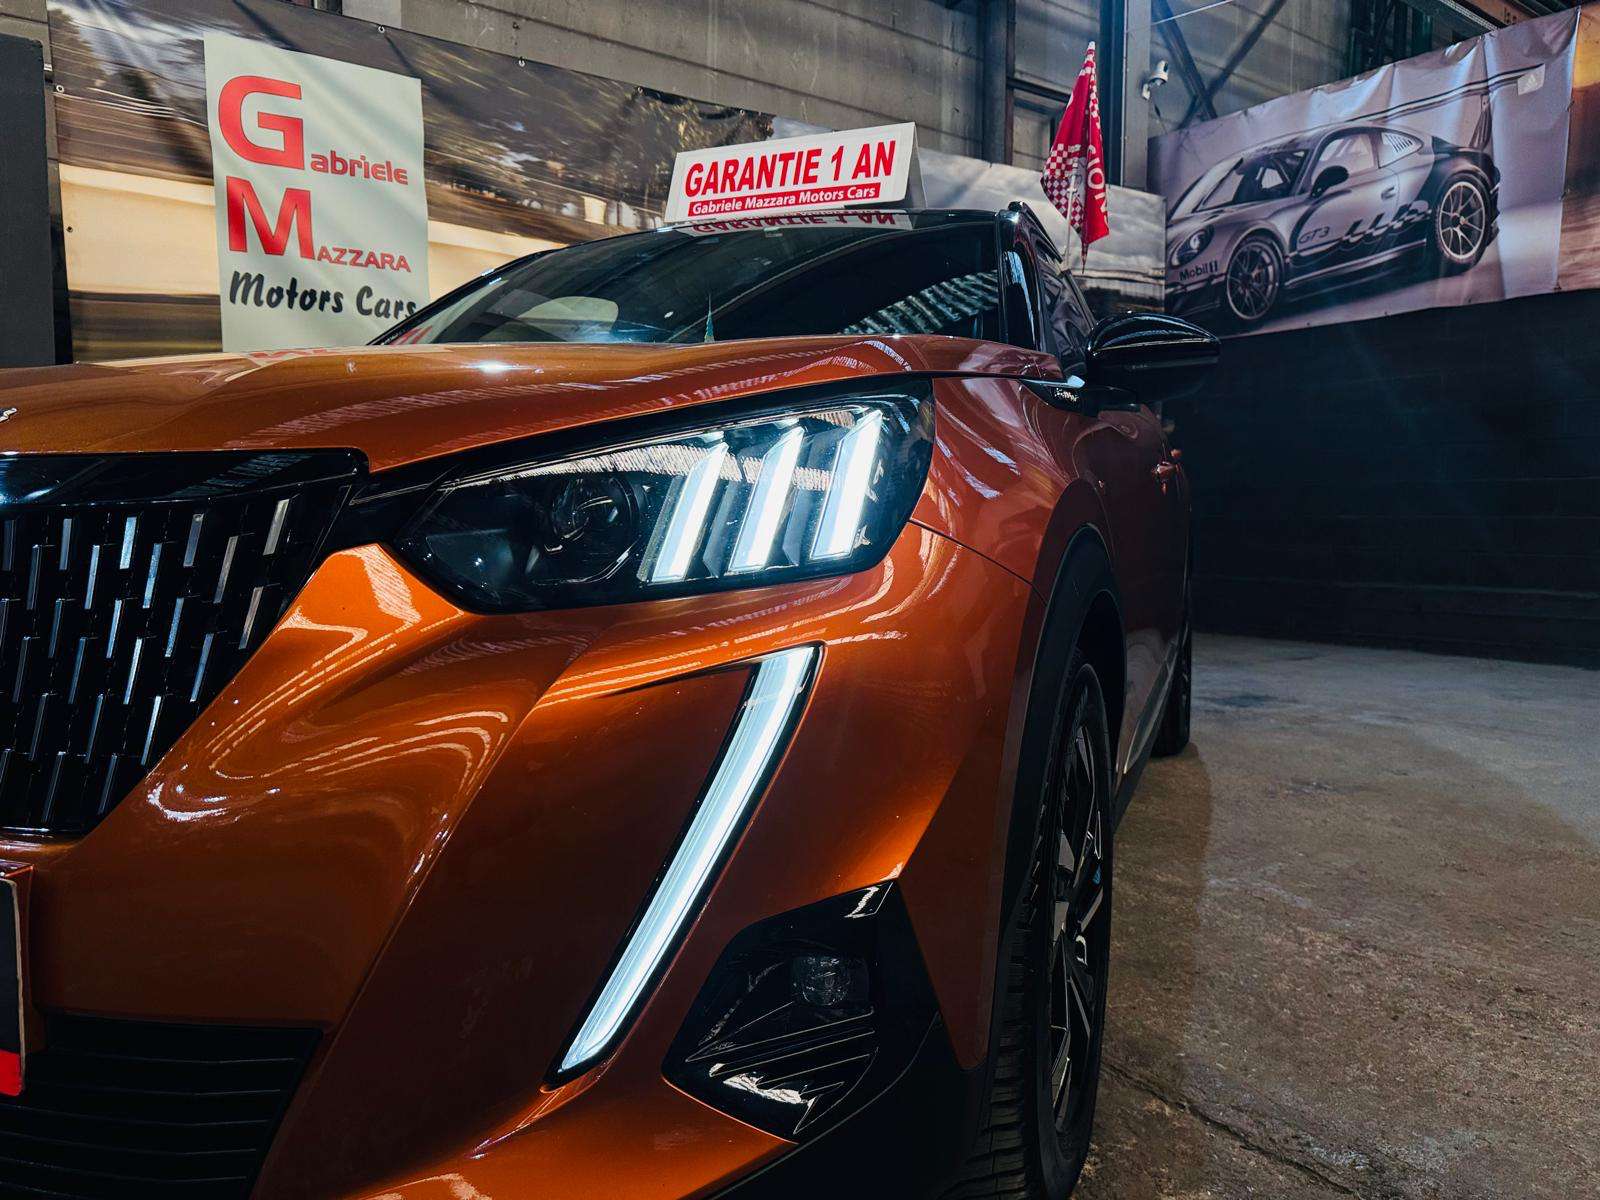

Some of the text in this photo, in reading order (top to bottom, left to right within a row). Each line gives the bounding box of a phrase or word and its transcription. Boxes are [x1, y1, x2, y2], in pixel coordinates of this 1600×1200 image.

[218, 75, 408, 186] Gabriele
[684, 140, 896, 198] GARANTIE 1 AN
[226, 175, 411, 273] MAZZARA
[692, 186, 876, 215] Gabriele Mazzara Motors Cars
[1299, 226, 1330, 244] GT3
[229, 270, 417, 320] Motors Cars
